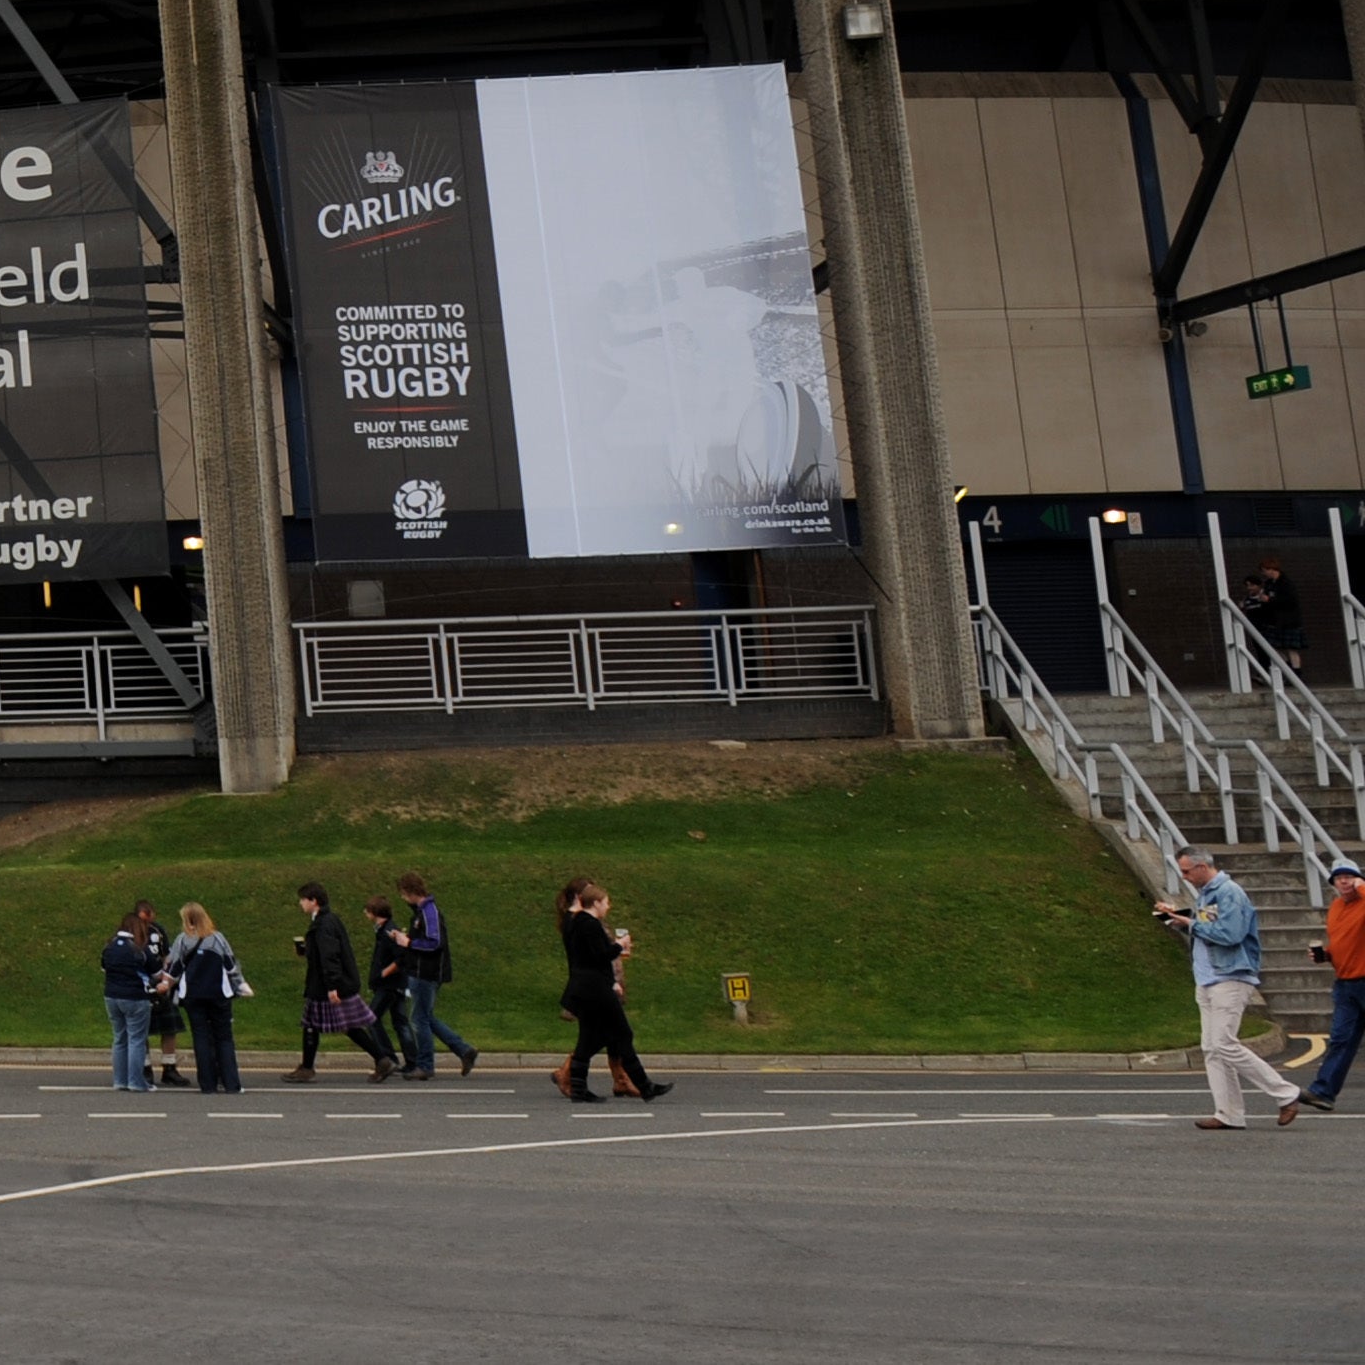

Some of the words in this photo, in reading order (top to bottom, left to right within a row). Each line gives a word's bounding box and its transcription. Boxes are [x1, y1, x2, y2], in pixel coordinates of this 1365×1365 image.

[318, 177, 459, 239] CARLING
[335, 305, 437, 321] COMMITTED
[442, 304, 465, 319] TO
[337, 322, 467, 342] SUPPORTING
[340, 342, 470, 367] SCOTTISH
[343, 366, 472, 399] RUGBY
[354, 421, 396, 434] ENJOY
[399, 420, 427, 432] THE
[430, 419, 470, 431] GAME
[367, 435, 459, 449] RESPONSIBLY
[395, 521, 448, 530] SCOTTISH
[745, 516, 831, 529] drinkaware.co.uk
[982, 505, 1003, 534] 4
[403, 530, 442, 539] RUGBY
[731, 979, 748, 998] H
